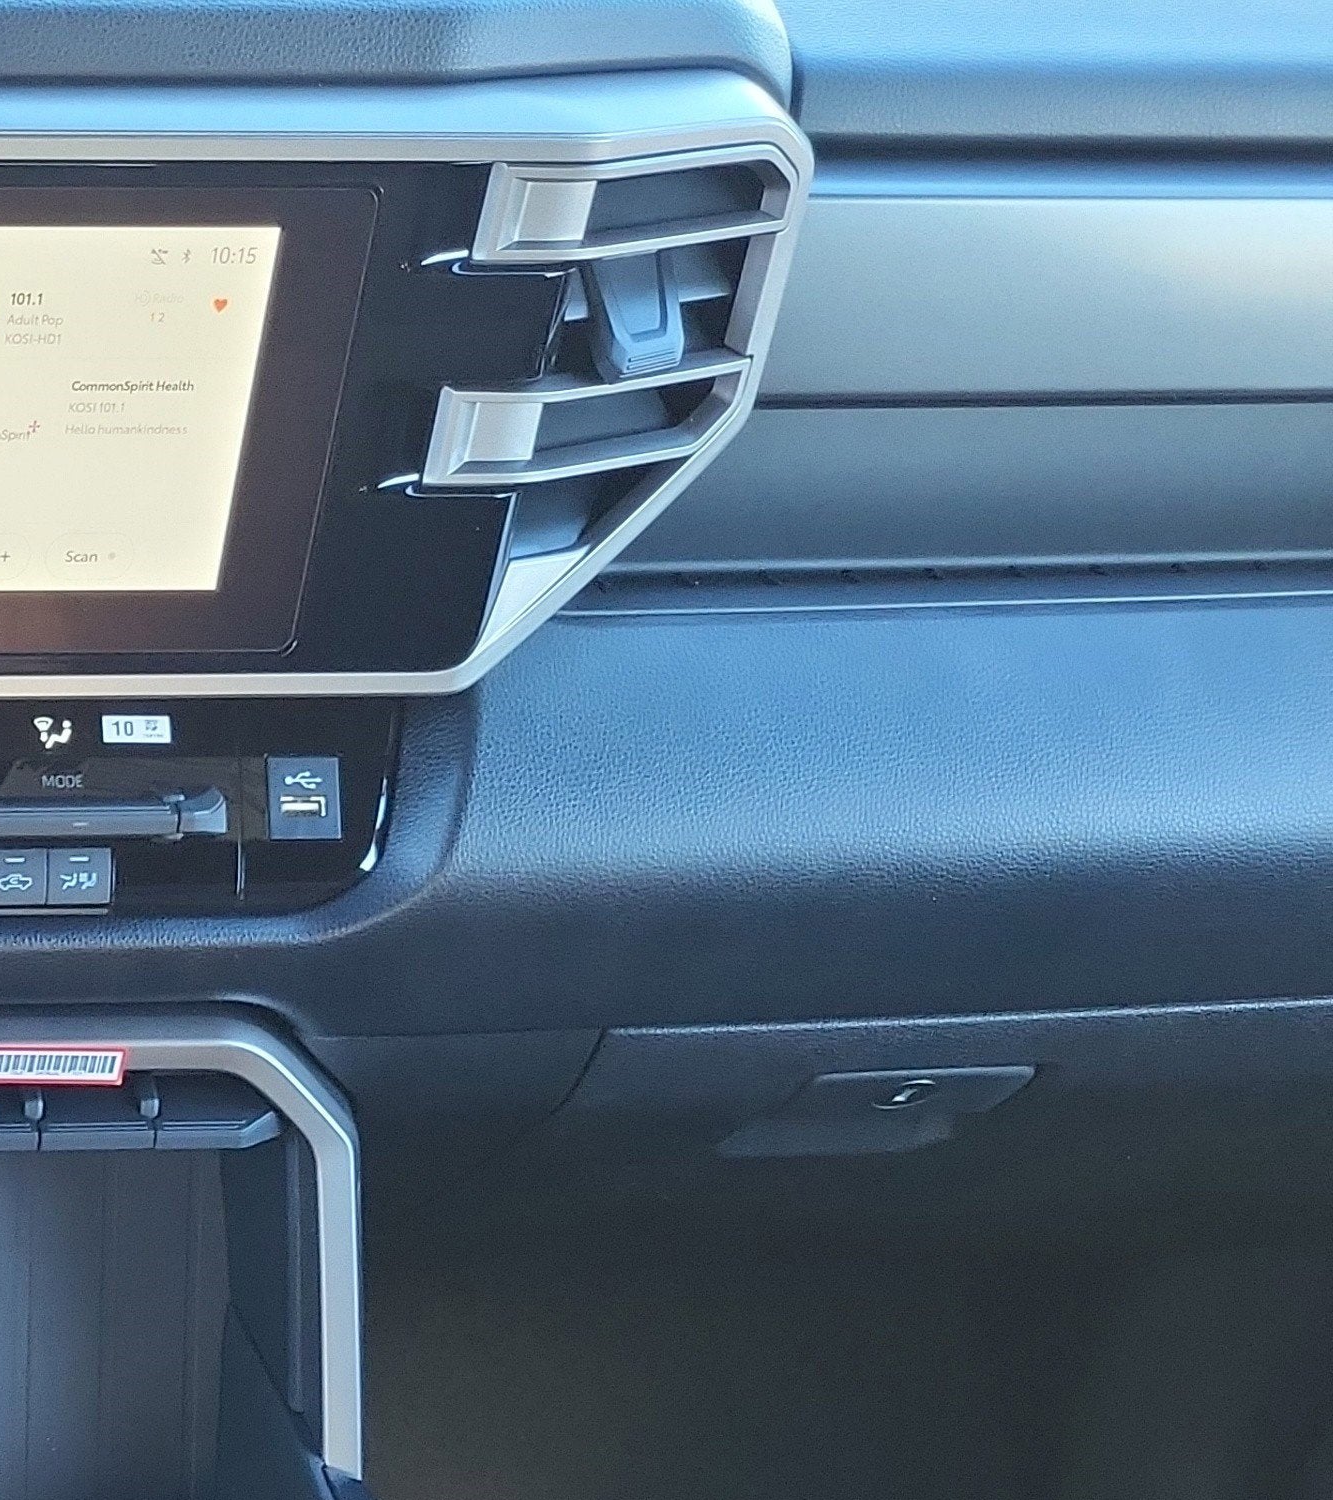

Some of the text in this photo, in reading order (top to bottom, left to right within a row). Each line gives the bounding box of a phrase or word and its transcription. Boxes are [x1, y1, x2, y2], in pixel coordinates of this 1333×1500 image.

[210, 246, 258, 264] 10:15
[10, 293, 43, 306] 101.1
[7, 314, 64, 328] Adult Pop
[5, 334, 61, 345] KOSI-HD1
[71, 380, 194, 393] CommonSpirit Health
[68, 402, 125, 414] KOSI 101.1
[65, 423, 188, 435] Hello humankindness
[65, 550, 98, 563] Scan
[111, 720, 135, 737] 10
[41, 774, 84, 789] MODE
